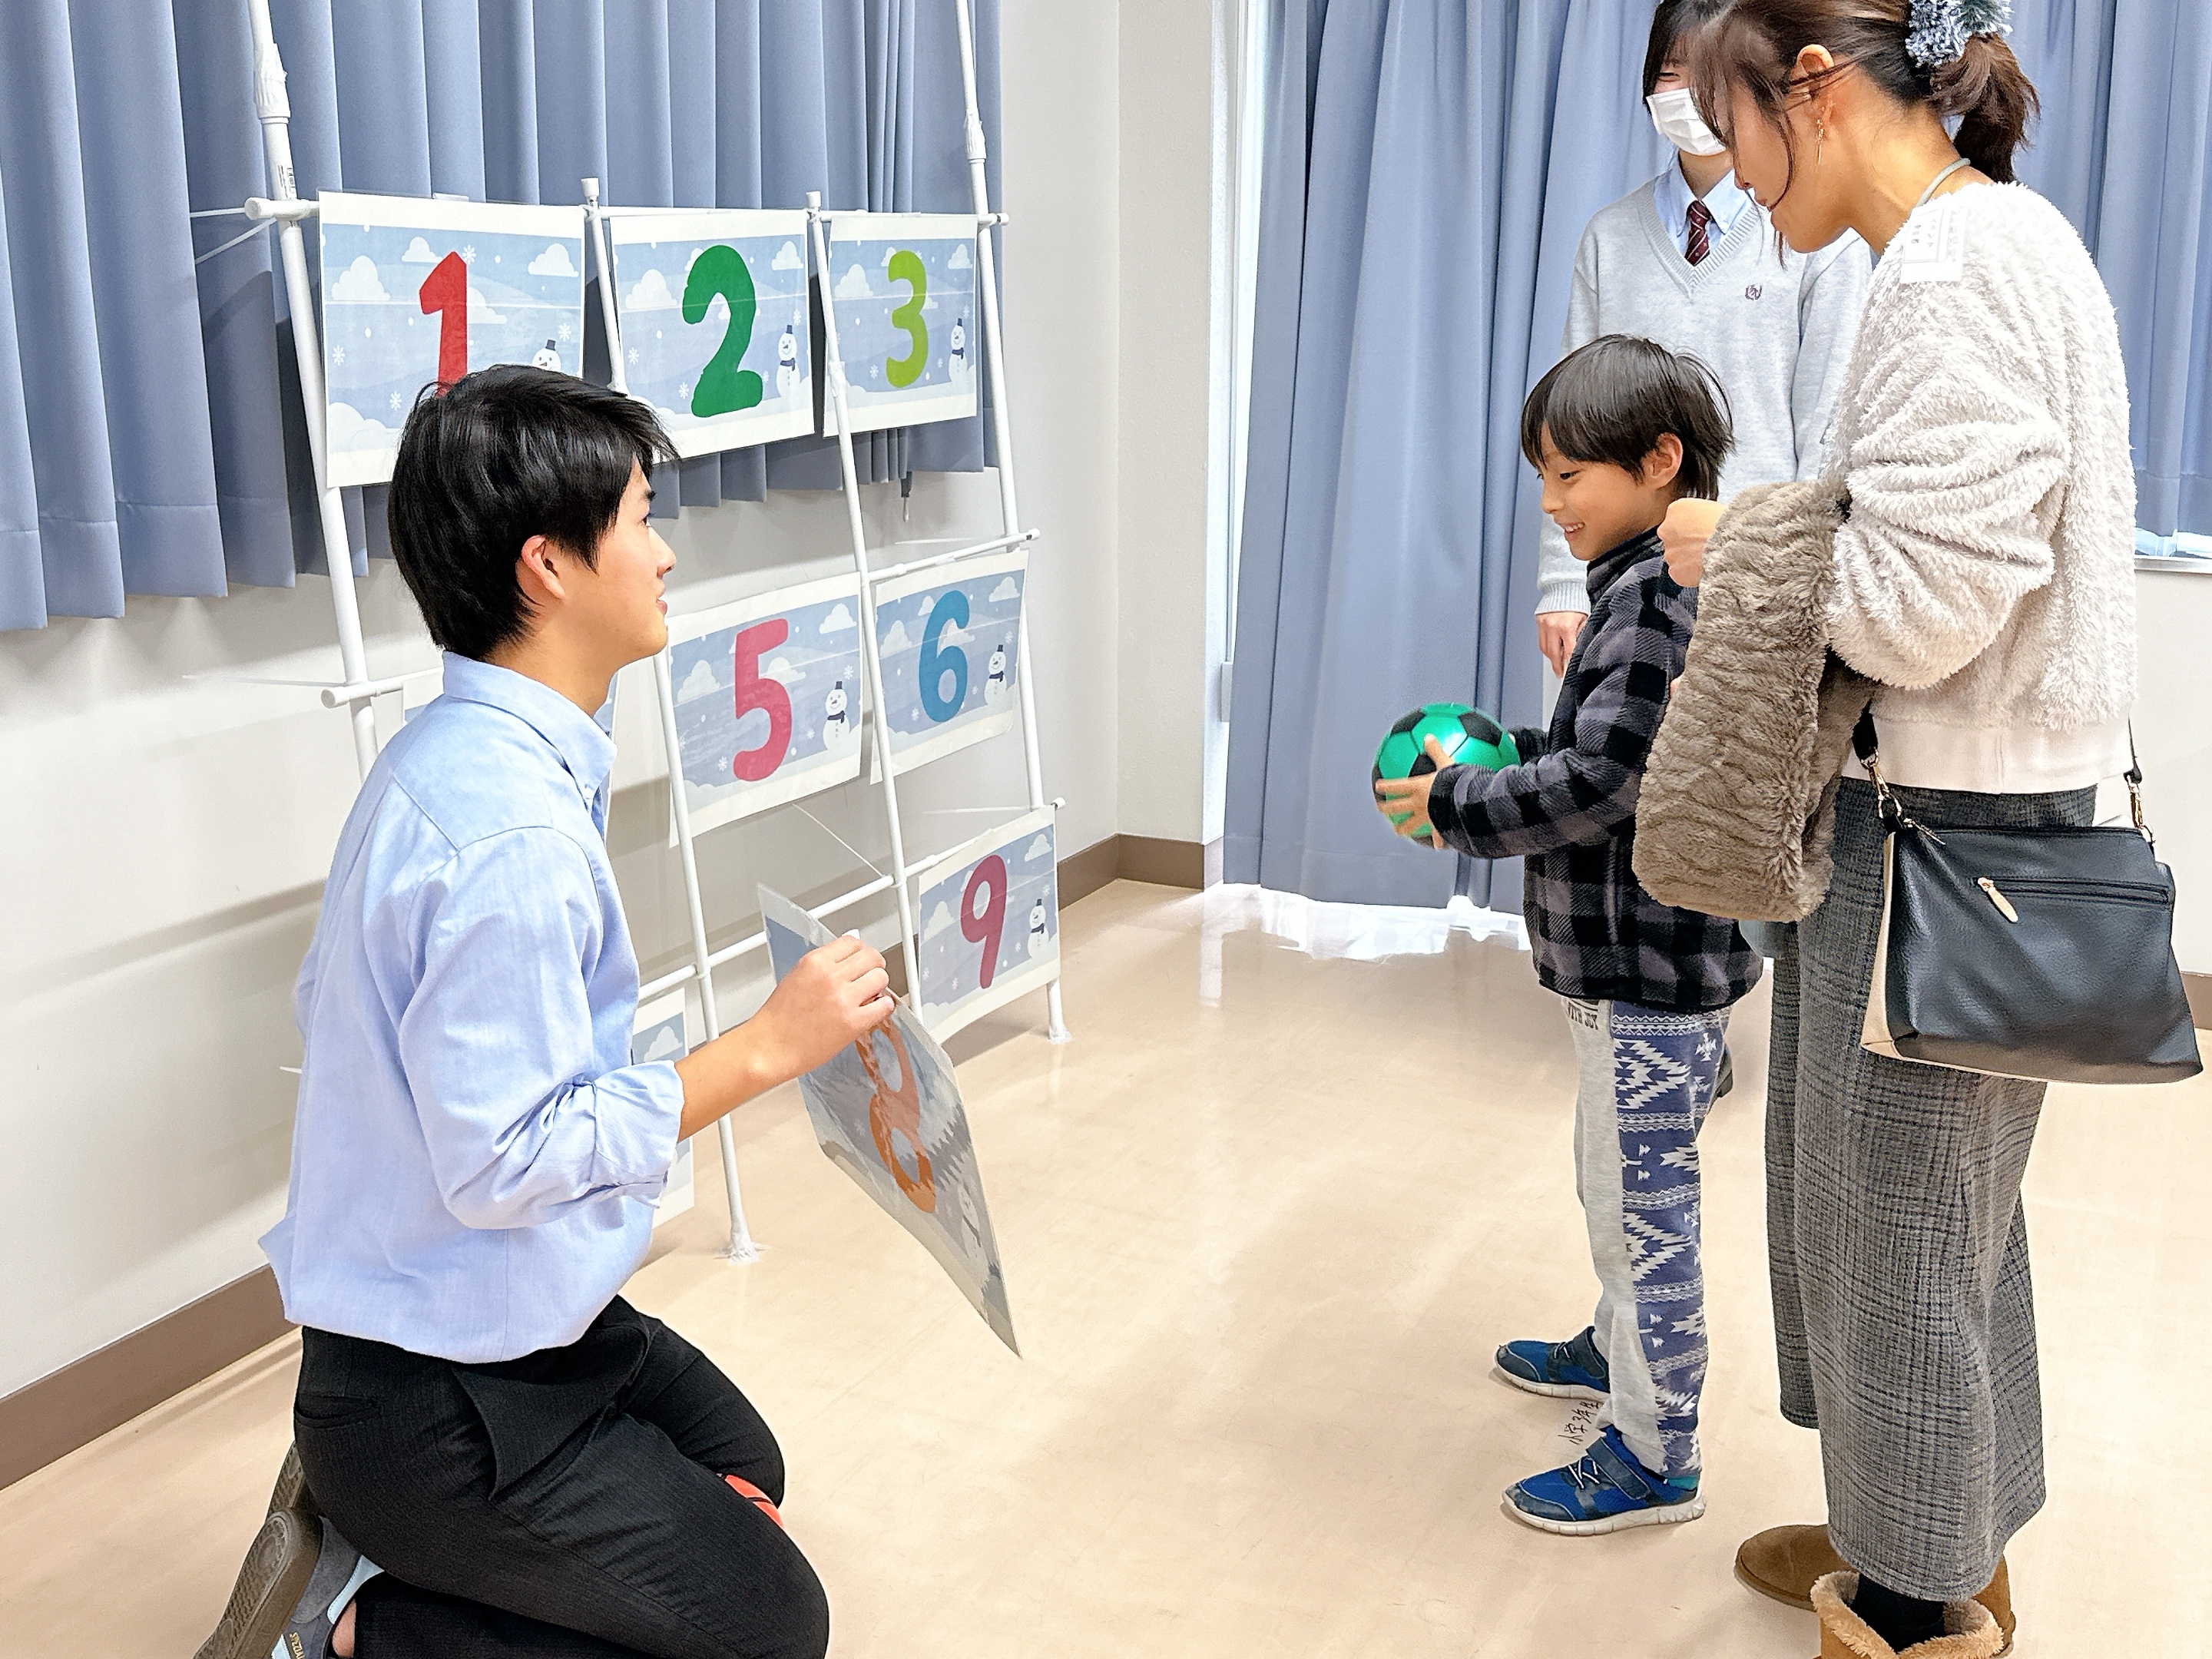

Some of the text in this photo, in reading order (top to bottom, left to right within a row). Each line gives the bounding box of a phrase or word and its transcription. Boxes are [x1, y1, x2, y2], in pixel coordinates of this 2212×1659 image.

[419, 251, 467, 397] 1
[682, 245, 763, 417] 2
[886, 250, 928, 388] 3
[733, 619, 792, 781] 5
[919, 591, 969, 722] 6
[960, 855, 1007, 988] 9
[856, 1017, 936, 1214] 8
